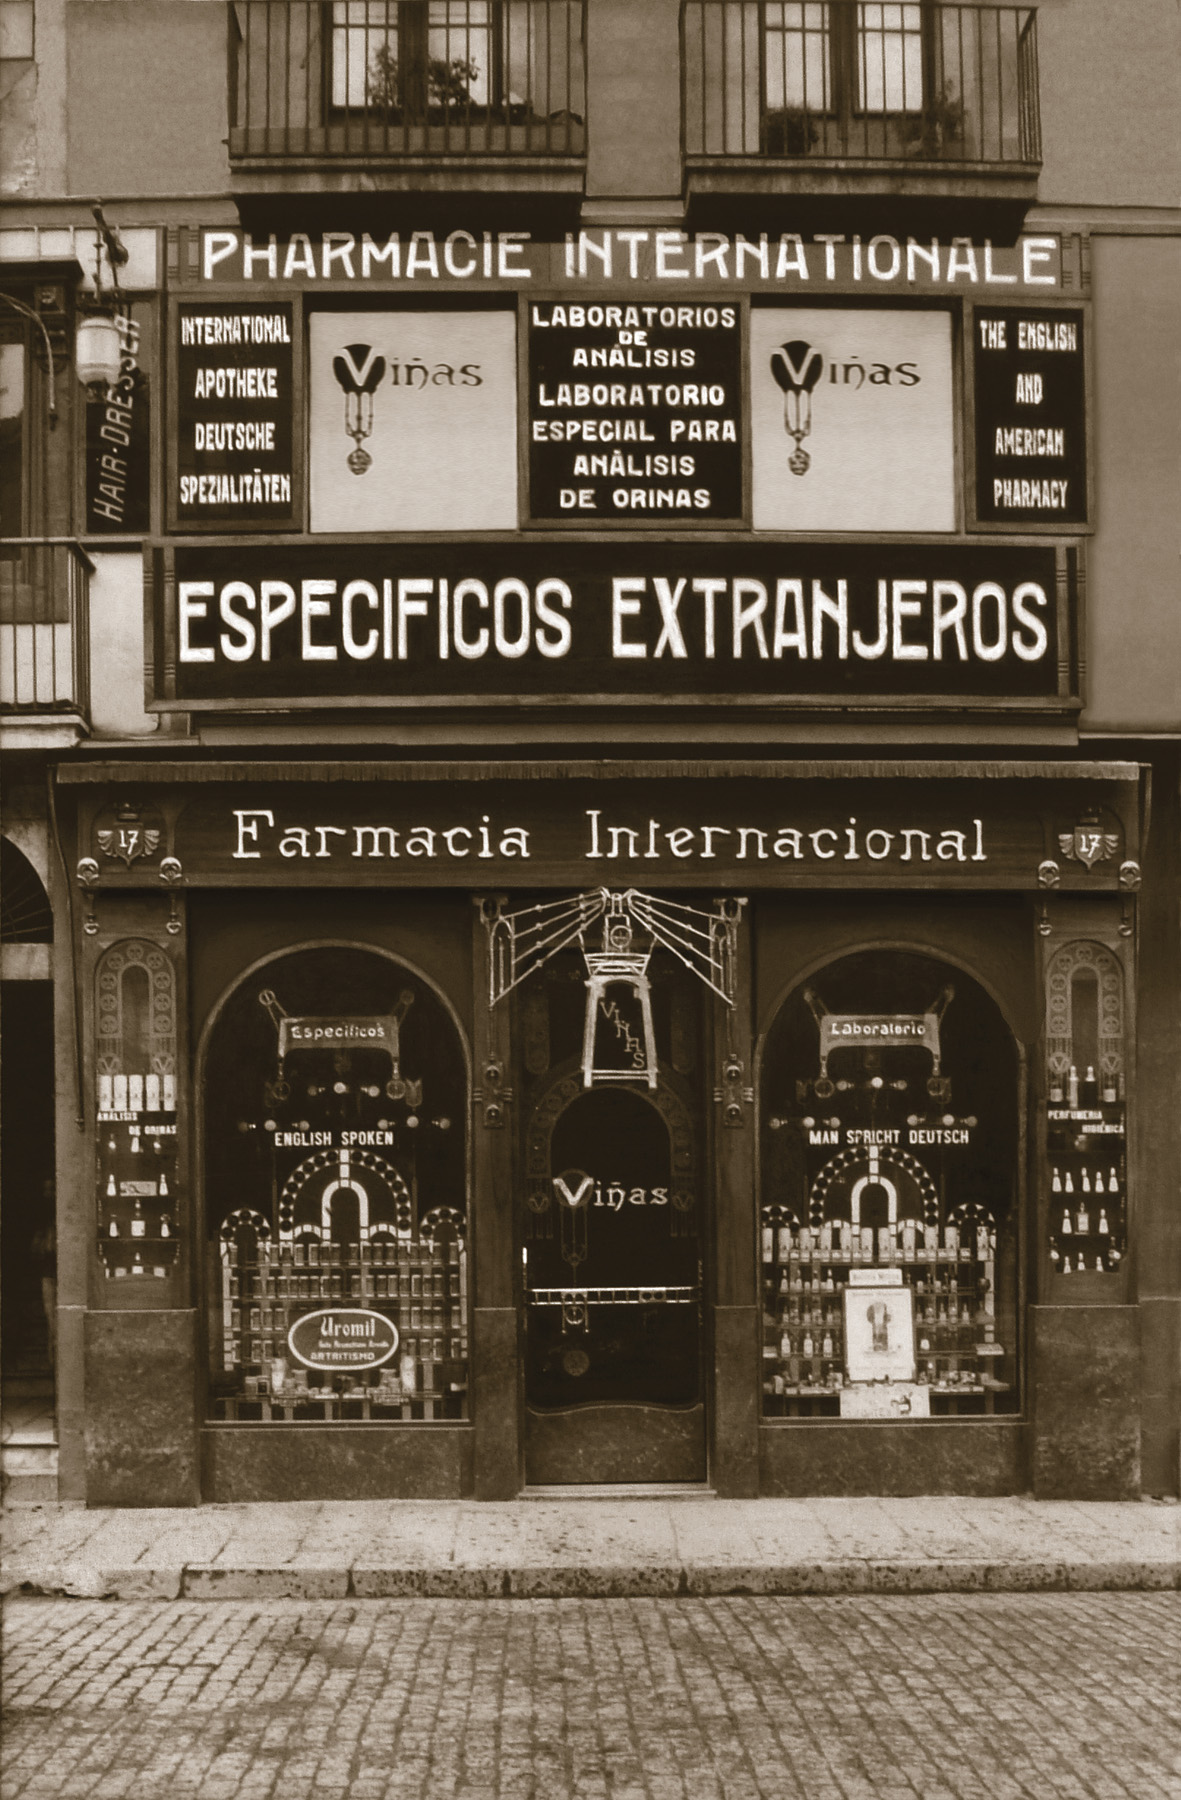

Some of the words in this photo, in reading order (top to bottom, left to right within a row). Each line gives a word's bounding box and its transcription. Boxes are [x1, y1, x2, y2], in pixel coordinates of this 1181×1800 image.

[203, 231, 532, 279] PHARMACIE
[564, 231, 1057, 286] INTERNATIONALE
[181, 315, 291, 345] INTERNATIONAL
[532, 306, 737, 328] LABORATORIOS
[618, 330, 648, 346] DE
[979, 320, 1007, 349] THE
[1018, 322, 1077, 351] ENGLISH
[335, 346, 484, 389] Viñas
[771, 344, 922, 391] Viñas
[195, 368, 279, 398] APOTHEKE
[539, 383, 726, 406] LABORATORIO
[1016, 373, 1044, 405] AND
[195, 423, 276, 451] DEUTSCHE
[532, 420, 655, 442] ESPECIAL
[670, 419, 737, 443] PARA
[995, 427, 1065, 457] AMERICAN
[180, 468, 291, 505] SPEZIALITÄTEN
[559, 489, 597, 509] DE
[612, 489, 711, 509] ORINAS
[993, 478, 1068, 509] PHARMACY
[178, 577, 572, 662] ESPECIFICOS
[611, 576, 1048, 661] EXTRANJEROS
[117, 829, 140, 855] 17
[232, 809, 531, 859] Farmacia
[585, 810, 987, 862] Internacional
[1077, 833, 1101, 857] 17
[275, 1132, 332, 1147] ENGLISH
[341, 1131, 394, 1146] SPOKEN
[809, 1130, 839, 1144] MAN
[846, 1130, 901, 1145] SPRICHT
[908, 1130, 969, 1144] DEUTSCH
[552, 1177, 668, 1211] Viñas
[321, 1316, 376, 1337] Uromil
